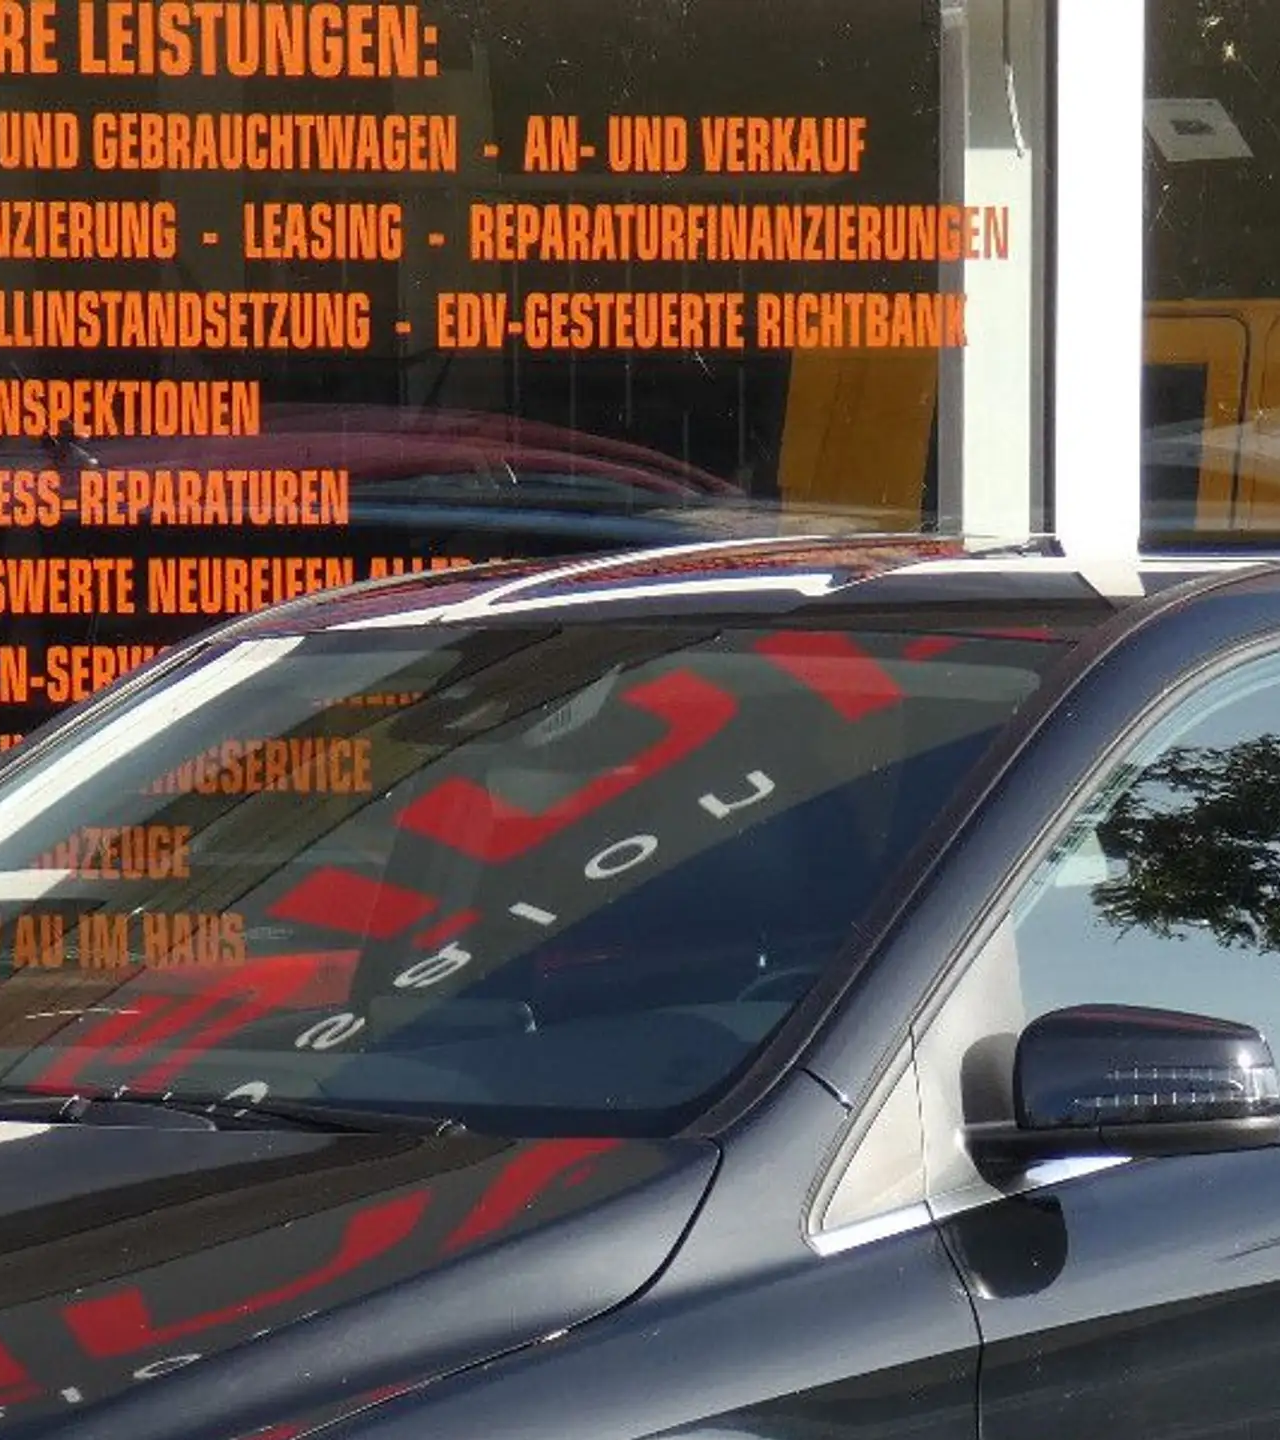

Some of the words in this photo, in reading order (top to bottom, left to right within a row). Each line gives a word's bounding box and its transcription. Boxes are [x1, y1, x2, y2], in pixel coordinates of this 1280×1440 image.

[79, 2, 438, 78] LEISTUNGEN:
[93, 113, 457, 172] GEBRAUCHTWAGEN
[524, 115, 595, 172] AN-
[608, 116, 687, 172] UND
[701, 116, 868, 173] VERKAUF
[244, 203, 404, 260] LEASING
[469, 203, 1009, 262] REPARATURFINANZIERUNGEN
[437, 293, 744, 349] EDV-GESTEUERTE
[757, 293, 969, 348] RICHTBANK
[13, 914, 64, 968] AU
[79, 914, 128, 969] IM
[143, 914, 246, 970] HAUS
